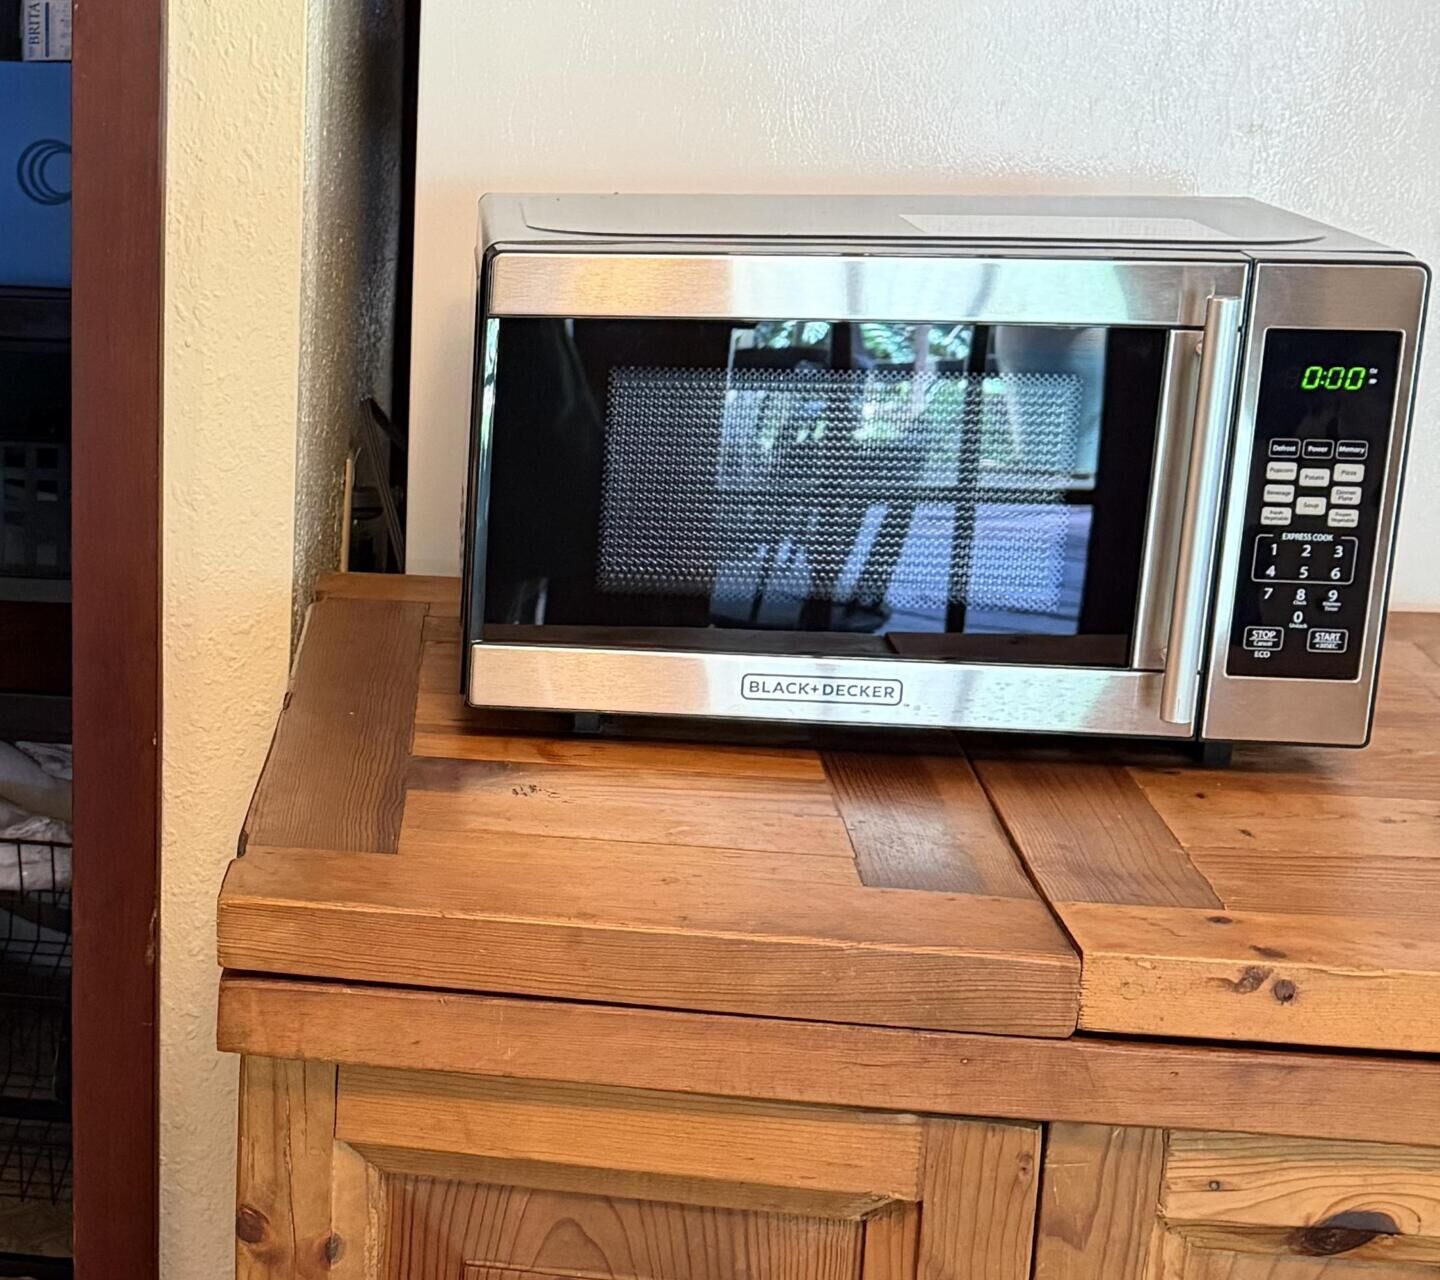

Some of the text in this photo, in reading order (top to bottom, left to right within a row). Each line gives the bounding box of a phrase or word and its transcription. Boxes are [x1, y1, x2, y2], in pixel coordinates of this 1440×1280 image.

[28, 2, 41, 45] BRITA
[1301, 366, 1366, 390] 0:00
[1282, 532, 1334, 542] EXPRESS COOK
[1271, 543, 1344, 558] 1 2 3
[1265, 565, 1341, 580] 4 5 6
[1264, 587, 1338, 601] 7 8 9
[1293, 611, 1303, 623] 0
[1252, 630, 1276, 639] STOP
[1314, 632, 1341, 641] START
[748, 680, 896, 699] BLACK+DECKER
